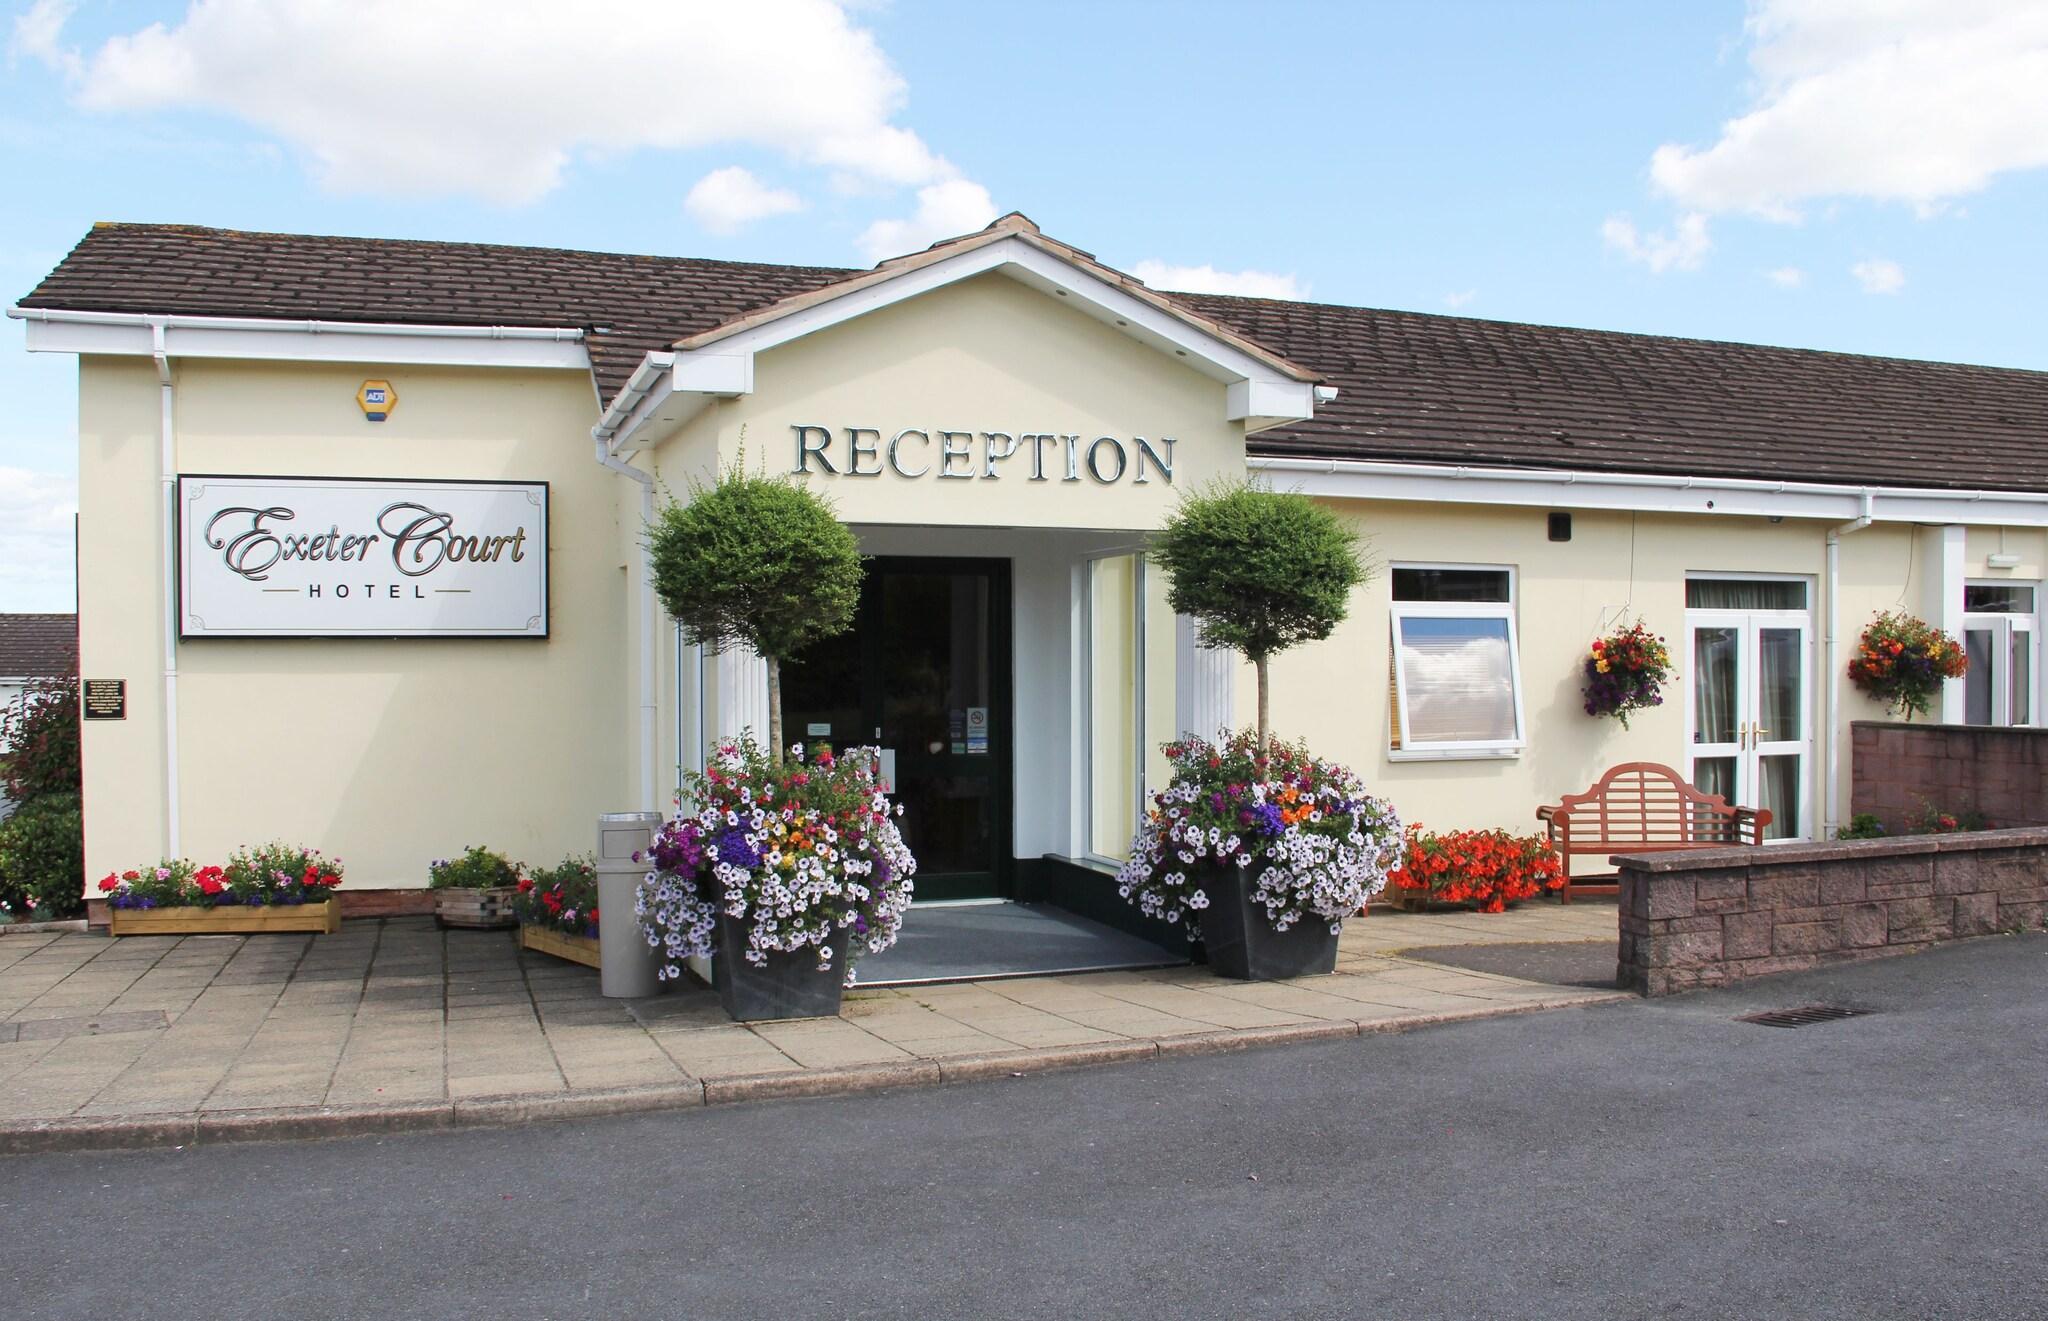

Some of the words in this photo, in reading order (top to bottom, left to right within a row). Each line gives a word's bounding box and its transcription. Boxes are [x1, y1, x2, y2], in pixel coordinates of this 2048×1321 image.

[790, 424, 1178, 484] RECEPTION
[204, 506, 379, 581] Exeter
[377, 501, 526, 576] Court
[309, 584, 425, 599] HOTEL
